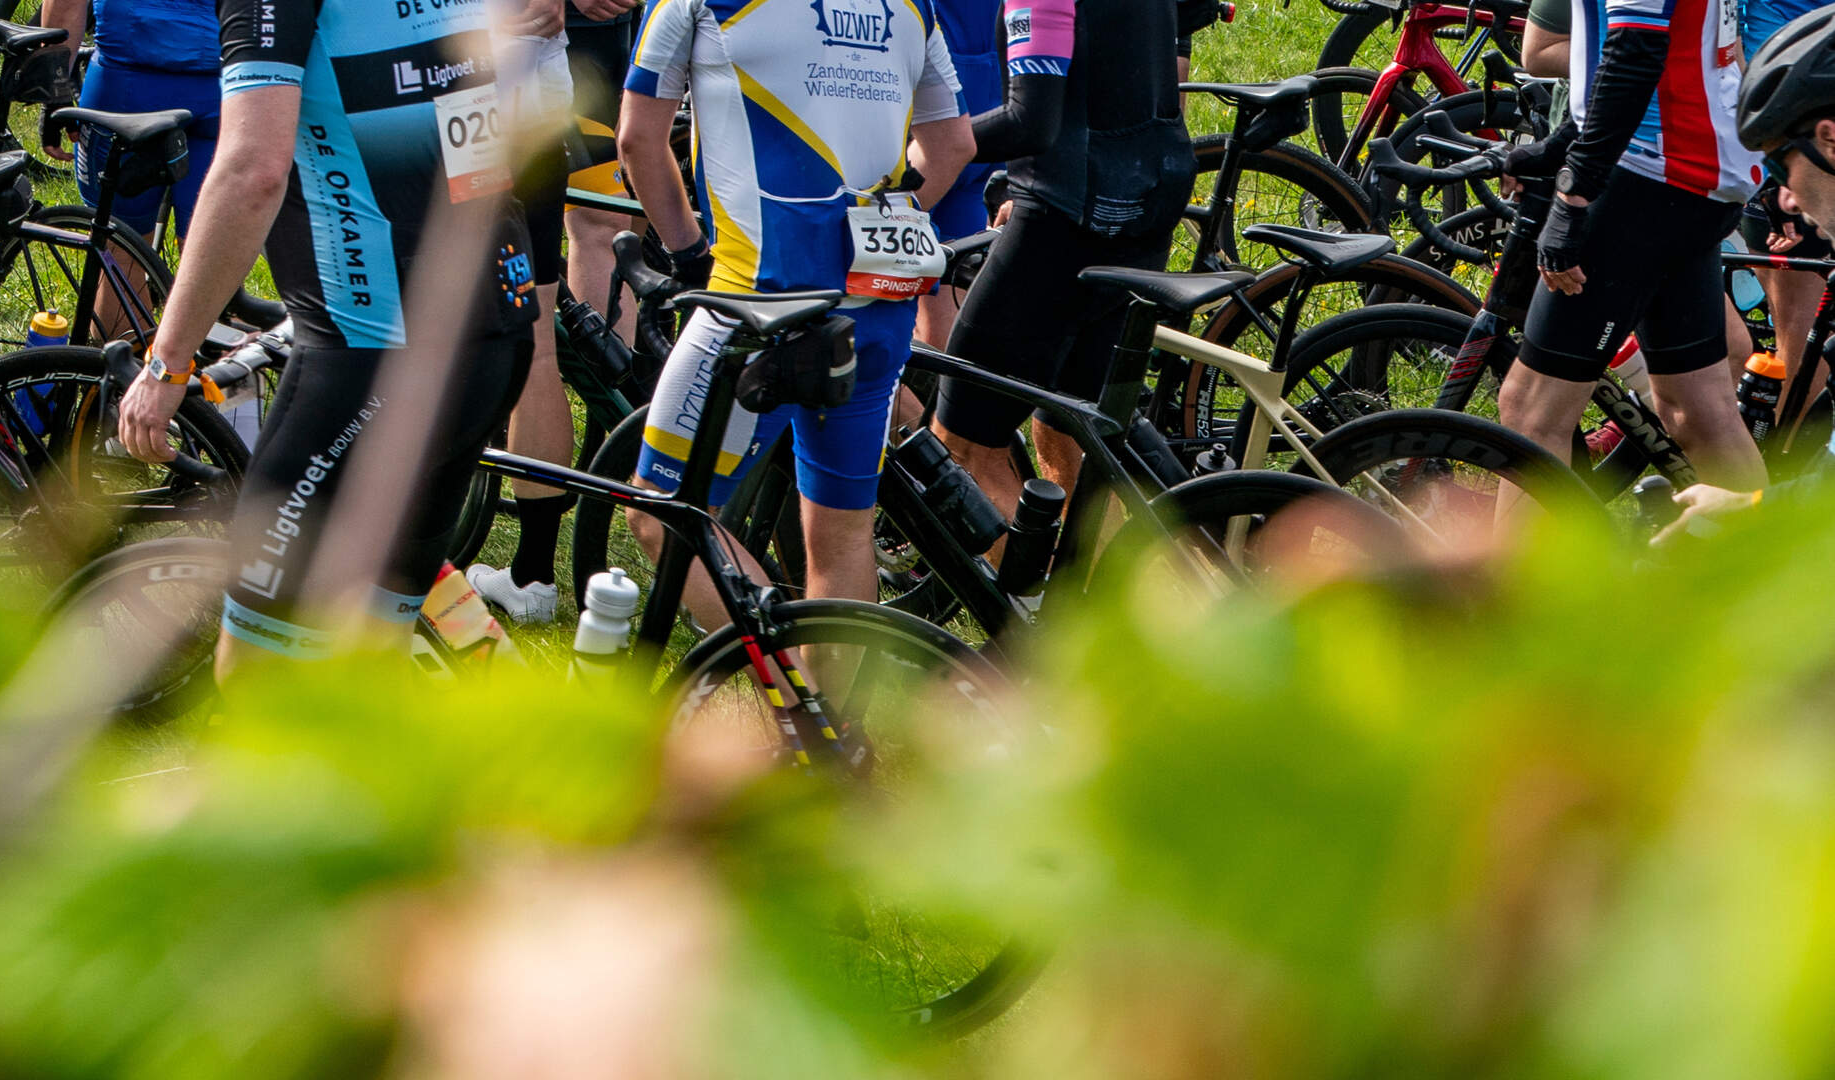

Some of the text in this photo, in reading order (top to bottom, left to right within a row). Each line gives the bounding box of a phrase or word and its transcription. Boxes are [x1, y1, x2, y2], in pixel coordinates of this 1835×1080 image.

[832, 9, 882, 43] DZWF
[426, 55, 475, 85] Ligtvoet
[806, 62, 900, 87] Zandvoortsche
[804, 80, 902, 105] WielerFederatie
[311, 125, 373, 308] DE OPKAMER
[864, 226, 934, 256] 33620
[261, 452, 335, 559] Ligtvoet
[327, 421, 366, 459] BOUW
